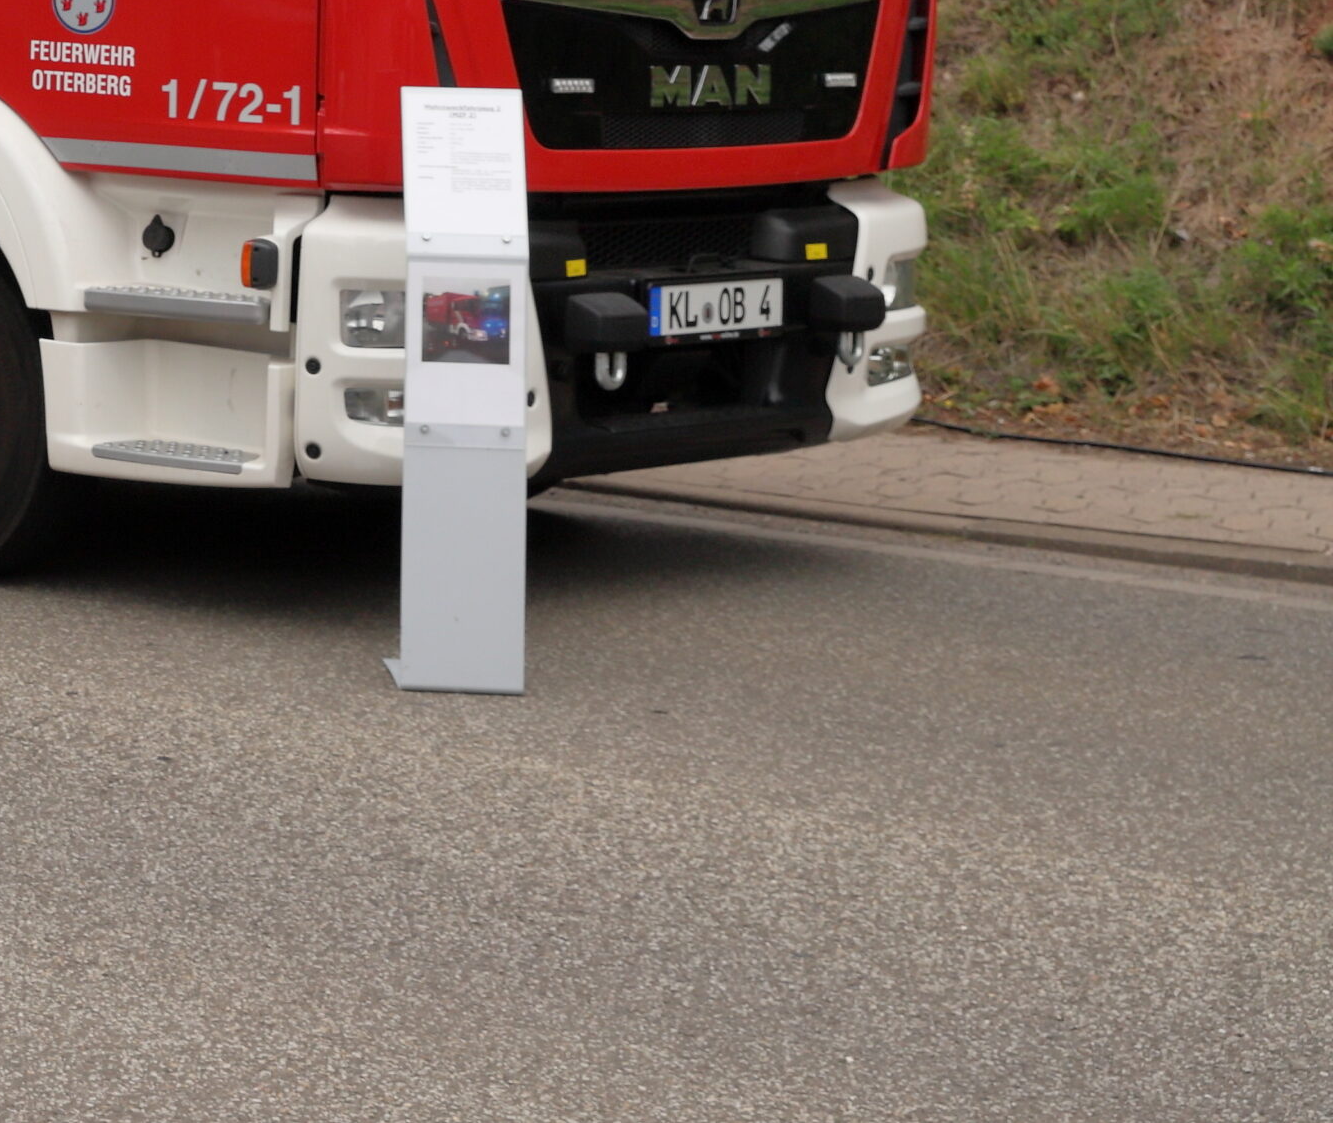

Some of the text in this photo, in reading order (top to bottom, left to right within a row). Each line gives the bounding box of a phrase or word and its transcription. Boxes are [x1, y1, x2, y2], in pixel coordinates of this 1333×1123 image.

[29, 39, 135, 67] FEUERWEHR
[31, 69, 132, 97] OTTERBERG
[160, 78, 302, 126] 1/72-1
[649, 64, 772, 108] MAN
[669, 284, 771, 329] KL OB 4
